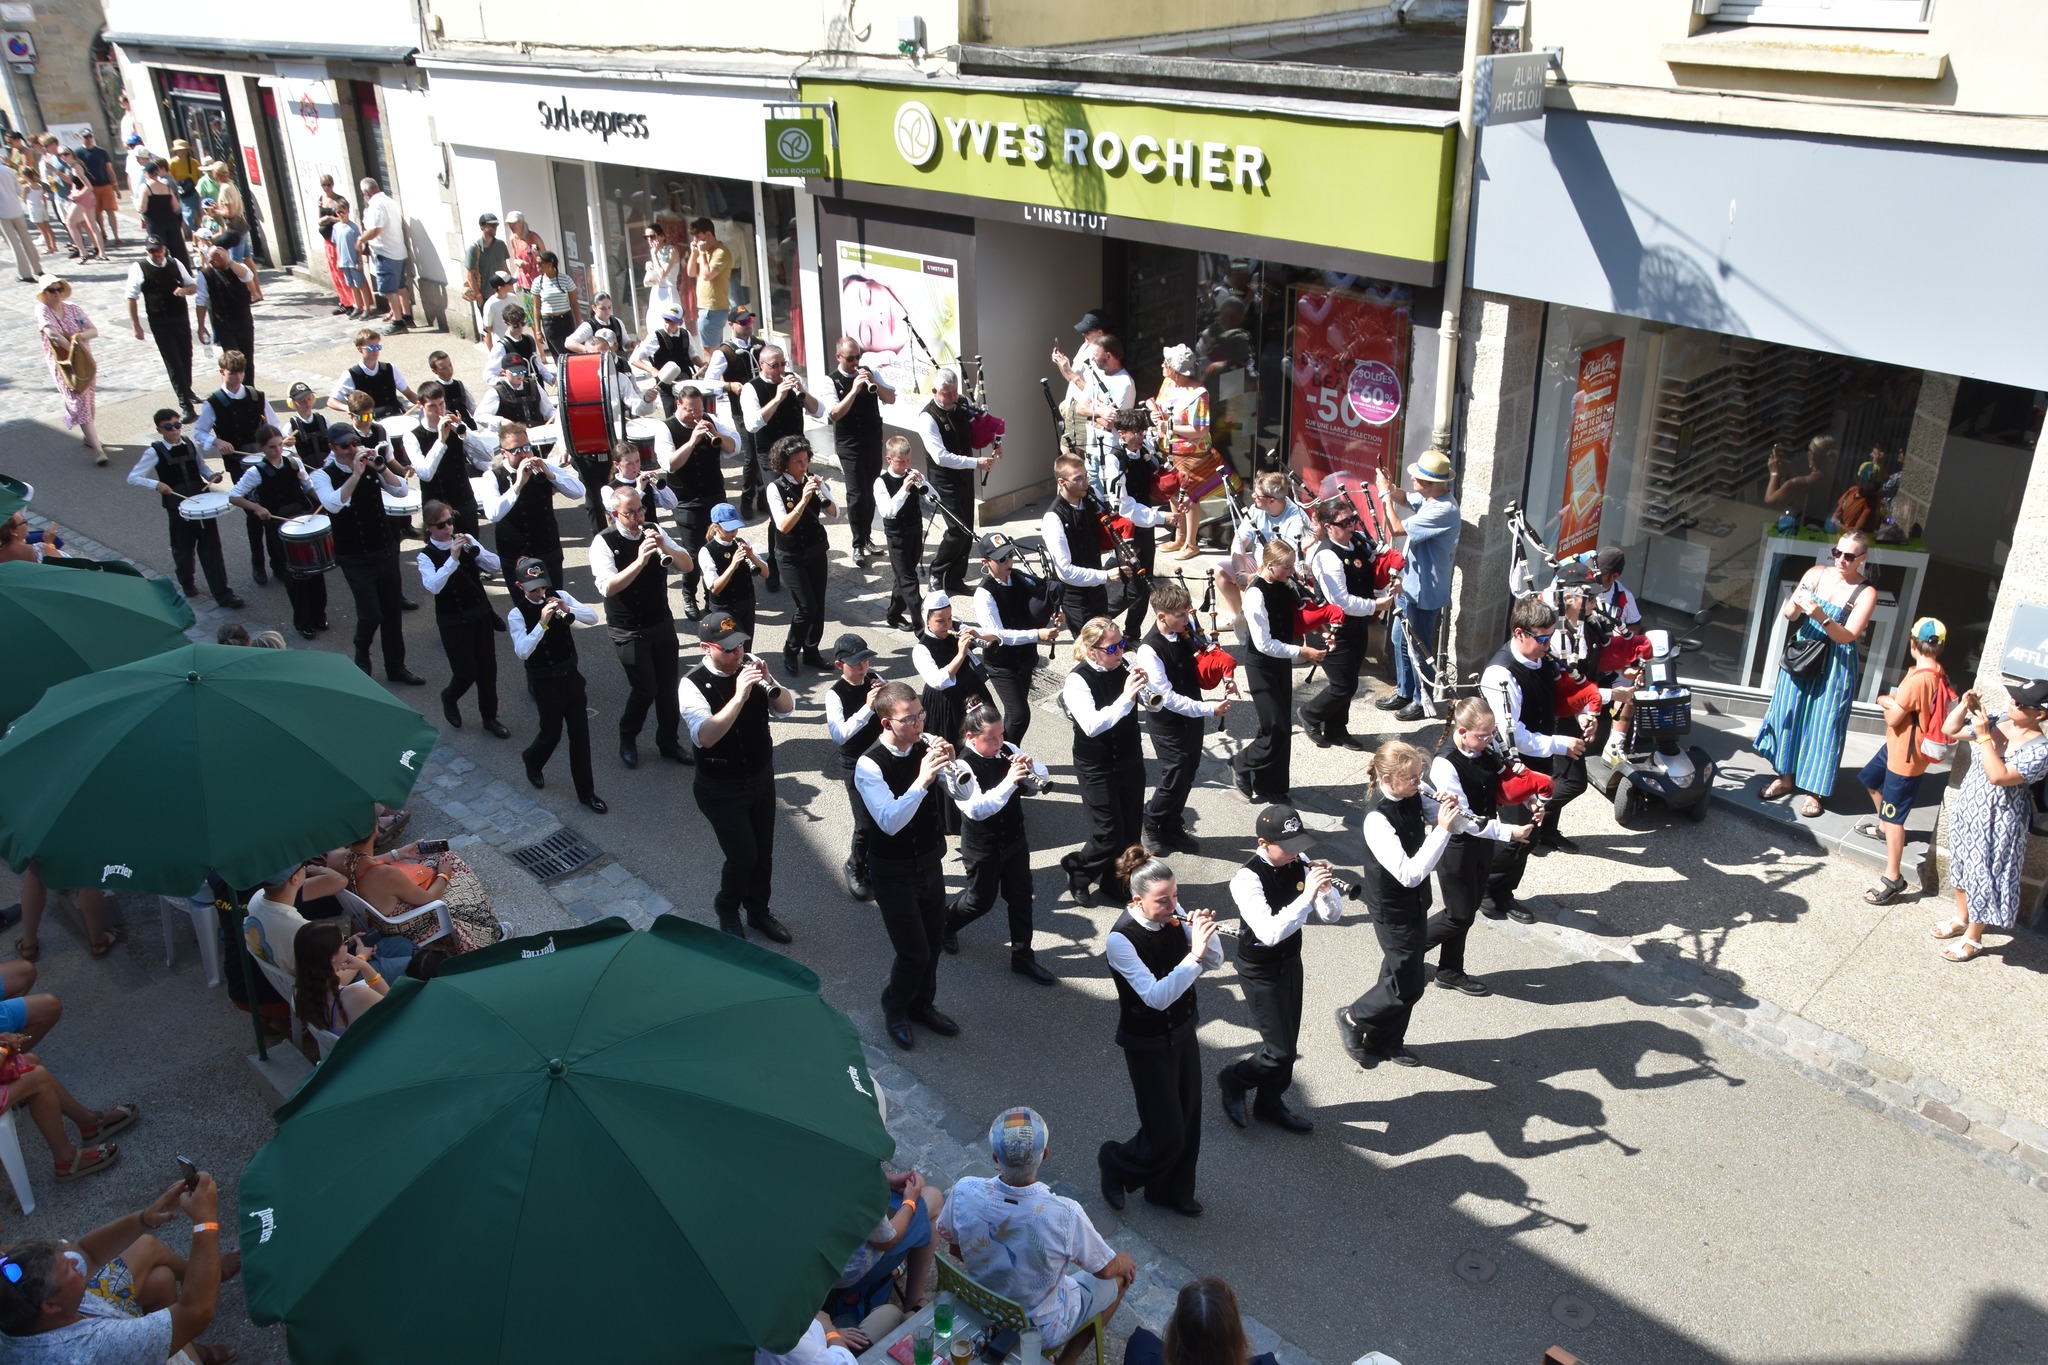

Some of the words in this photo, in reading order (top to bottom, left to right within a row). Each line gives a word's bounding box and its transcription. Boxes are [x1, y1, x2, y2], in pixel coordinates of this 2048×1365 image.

[1512, 65, 1544, 87] ALAIN
[1493, 89, 1542, 114] AFFLELOU
[944, 116, 1047, 162] YVES
[1063, 127, 1265, 187] ROCHER
[771, 167, 789, 175] YVES
[790, 167, 821, 175] ROCHER
[1023, 205, 1108, 231] L'INSTITUT
[904, 360, 931, 377] Gstes
[1358, 369, 1393, 385] SOLDES
[1354, 385, 1395, 406] -60%
[1307, 387, 1366, 428] -50
[1305, 419, 1316, 427] SUR
[1317, 421, 1329, 430] UNE
[1330, 424, 1349, 435] LARGE
[1350, 429, 1383, 443] SÉLECTION
[1881, 800, 1896, 819] 10
[101, 863, 133, 883] perrier
[520, 936, 556, 959] perrier
